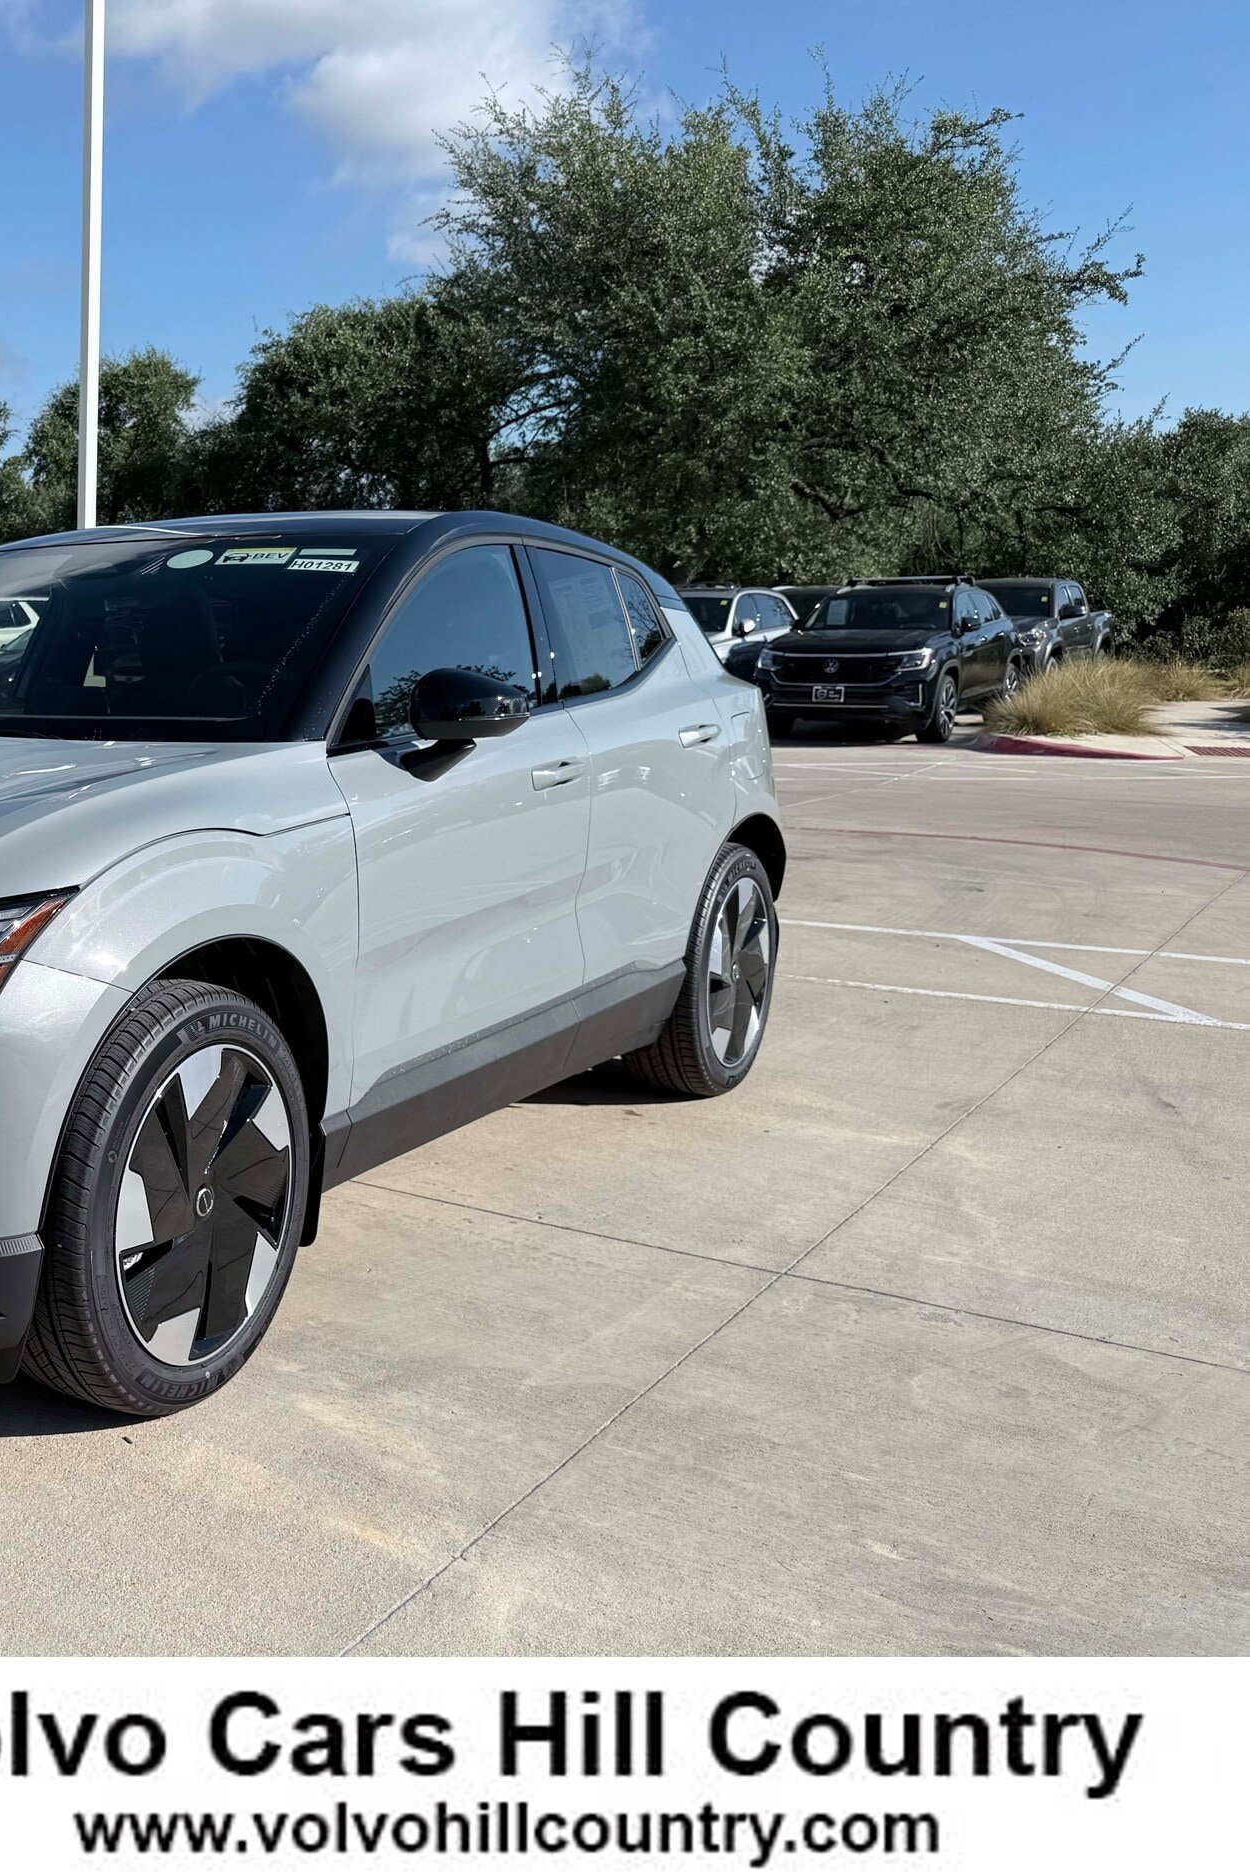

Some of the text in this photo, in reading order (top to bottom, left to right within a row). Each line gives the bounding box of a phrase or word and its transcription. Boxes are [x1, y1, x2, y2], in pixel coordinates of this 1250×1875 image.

[253, 552, 290, 560] BEV
[291, 560, 352, 571] H01281
[209, 1014, 278, 1049] MICHELIN
[140, 1373, 219, 1399] MICHELIN
